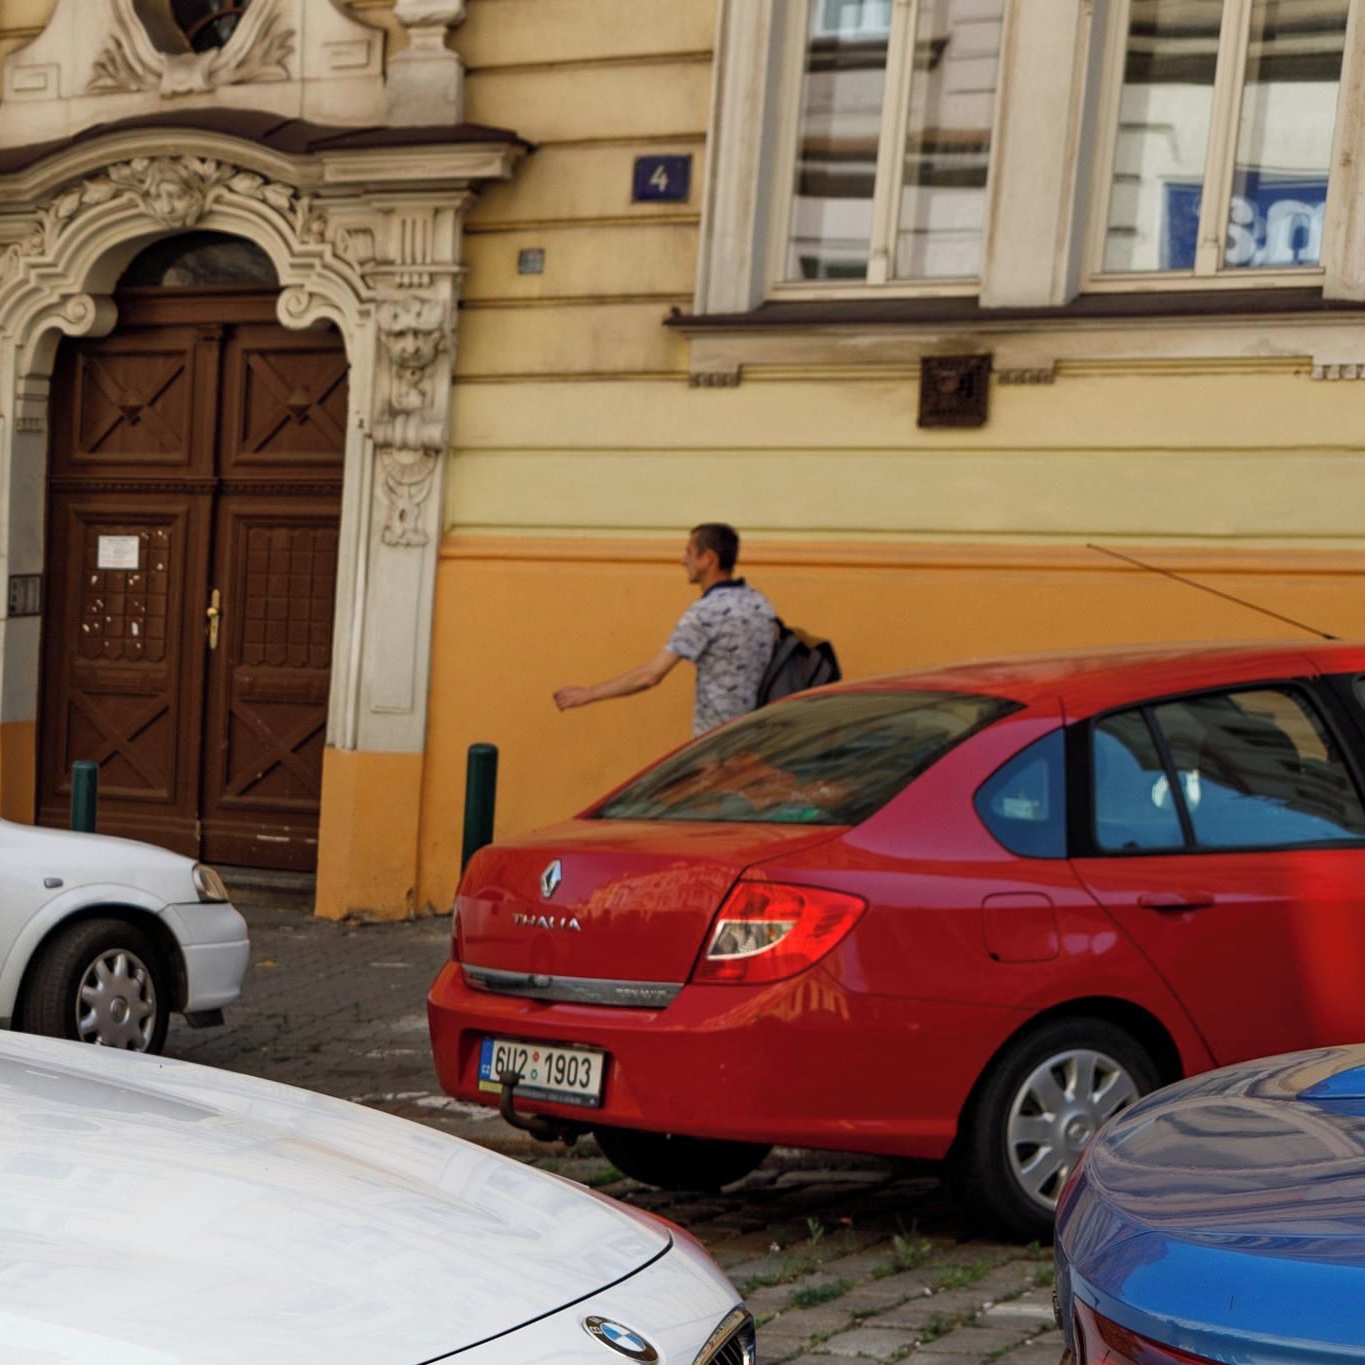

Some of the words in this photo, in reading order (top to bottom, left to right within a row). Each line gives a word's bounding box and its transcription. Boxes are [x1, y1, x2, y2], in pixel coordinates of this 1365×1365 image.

[649, 164, 669, 192] 4
[511, 912, 582, 932] THALIA
[495, 1045, 528, 1081] 6U2
[544, 1052, 592, 1089] 1903
